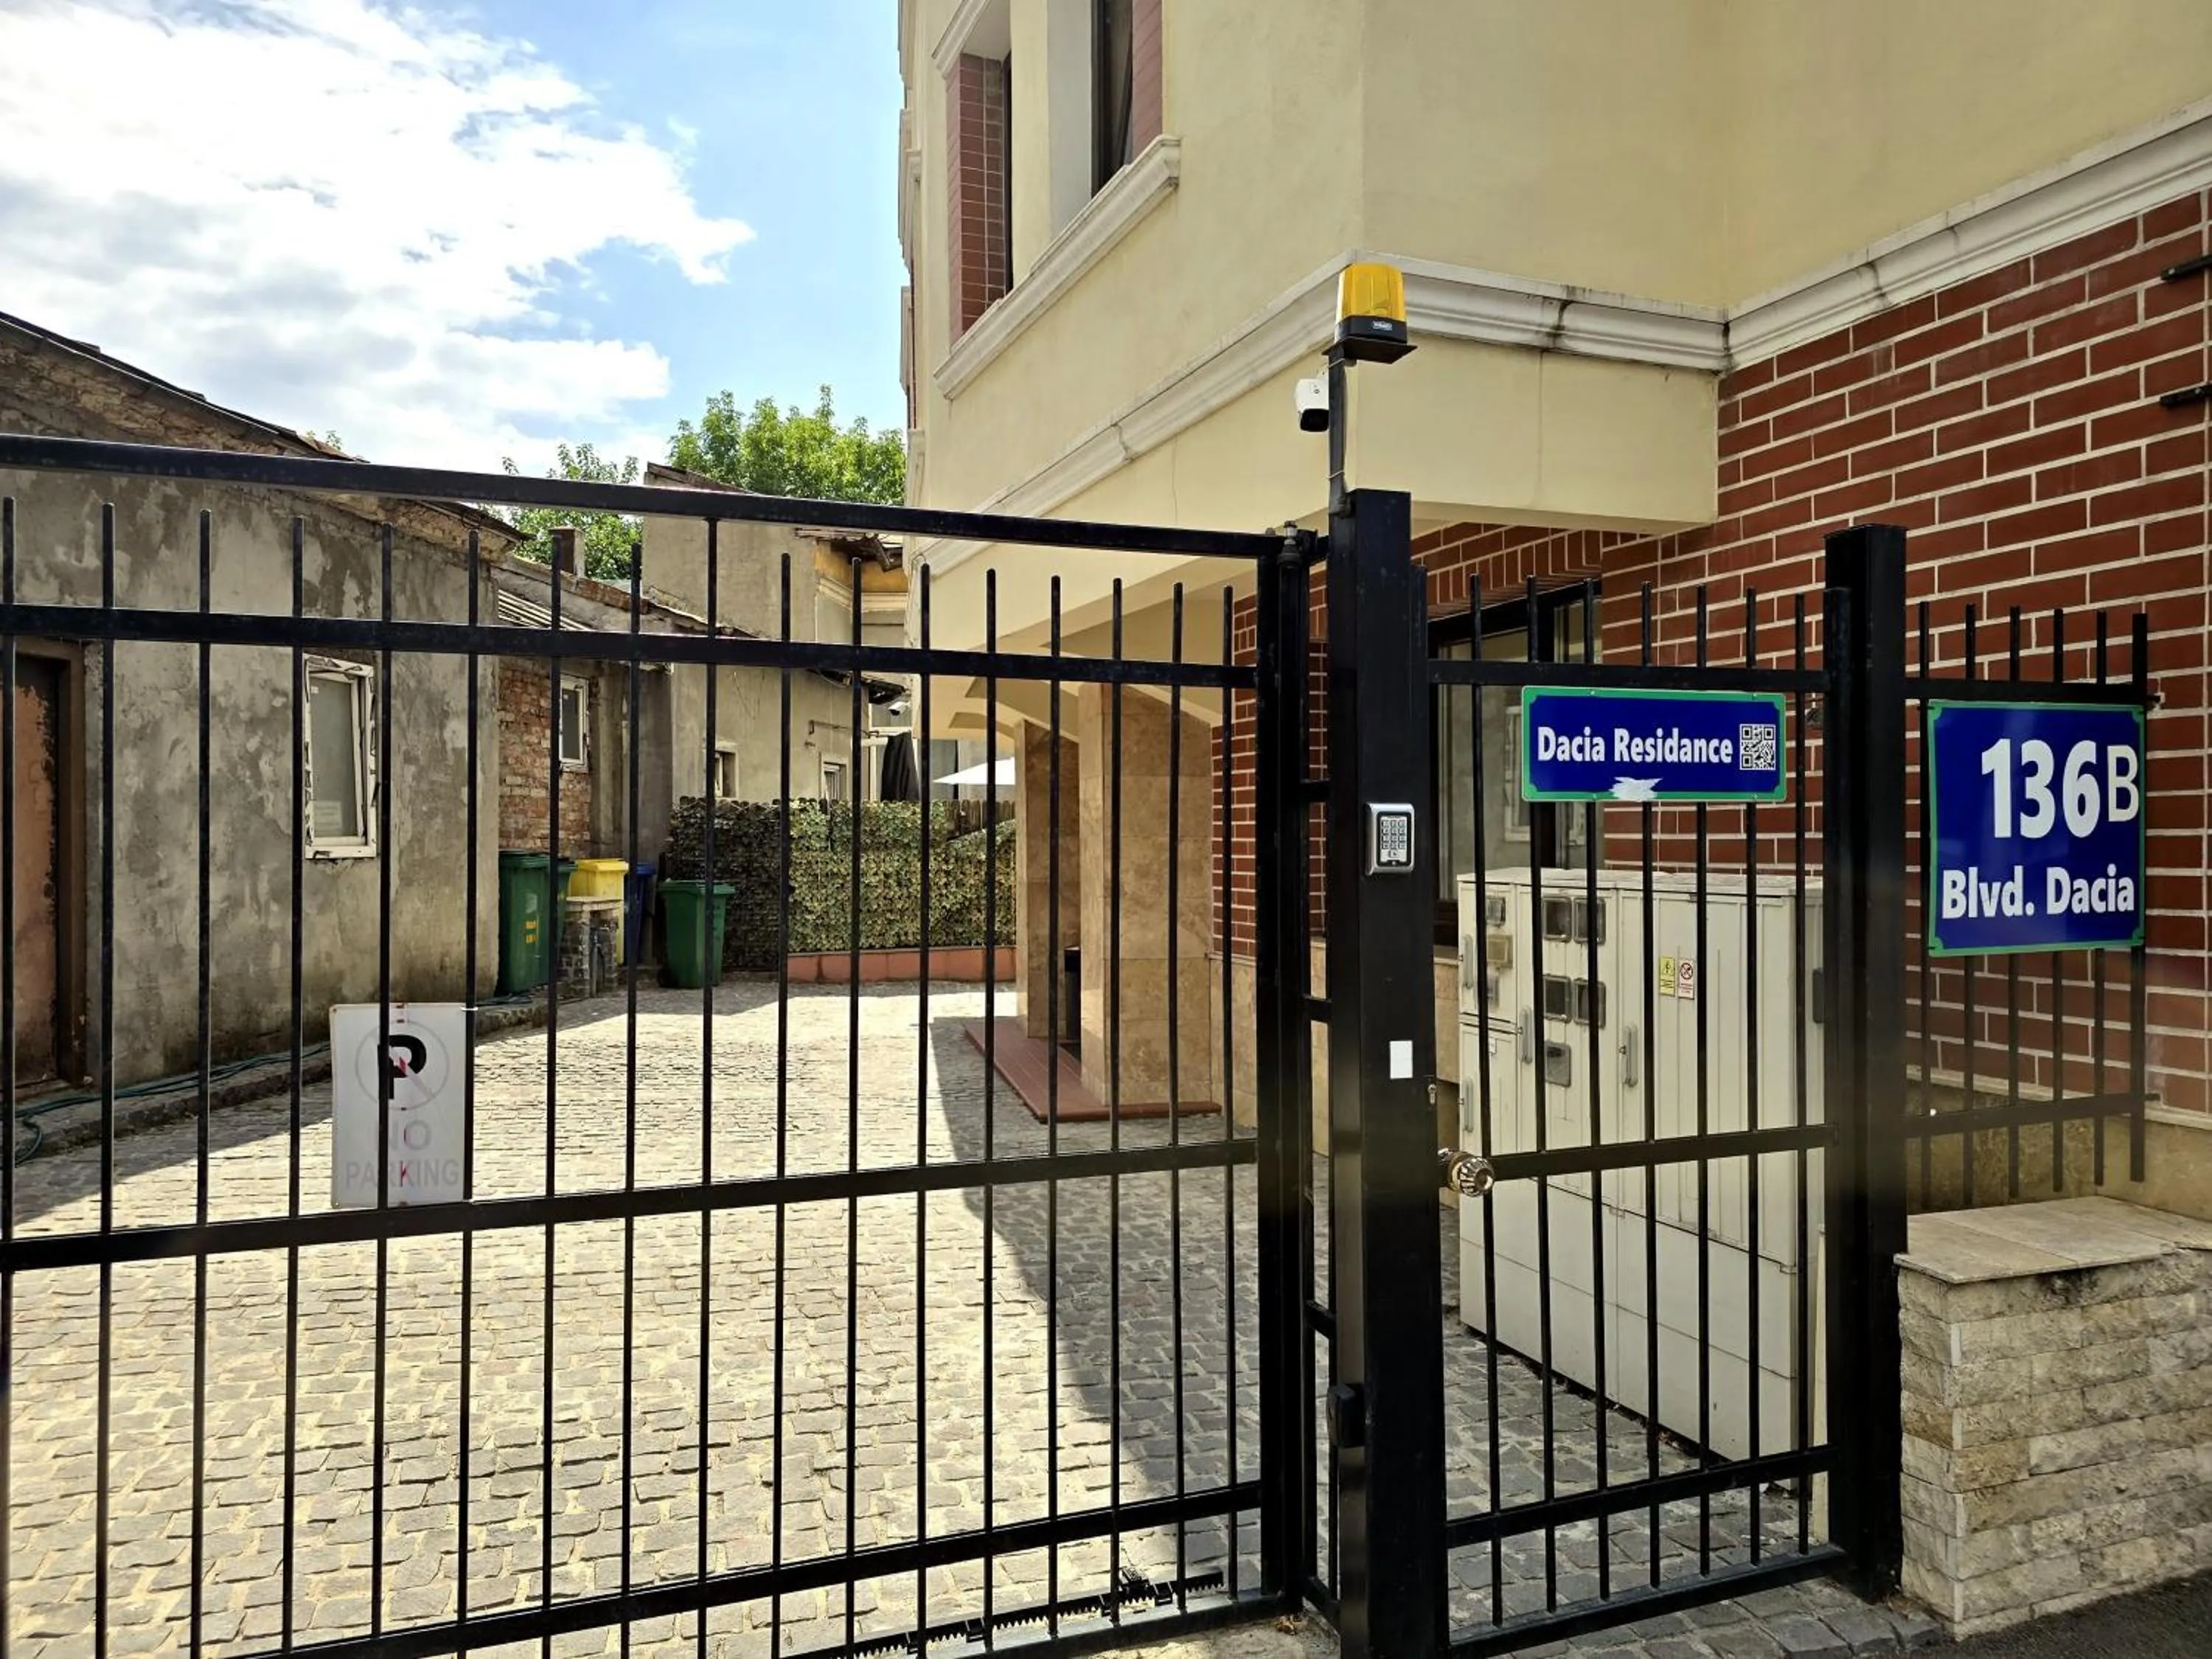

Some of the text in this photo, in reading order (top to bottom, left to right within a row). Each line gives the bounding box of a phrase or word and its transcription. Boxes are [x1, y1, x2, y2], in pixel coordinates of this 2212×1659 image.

[1537, 726, 1733, 763] Dacia Residance
[1981, 738, 2139, 838] 136B
[1942, 863, 2135, 919] Blvd. Dacia
